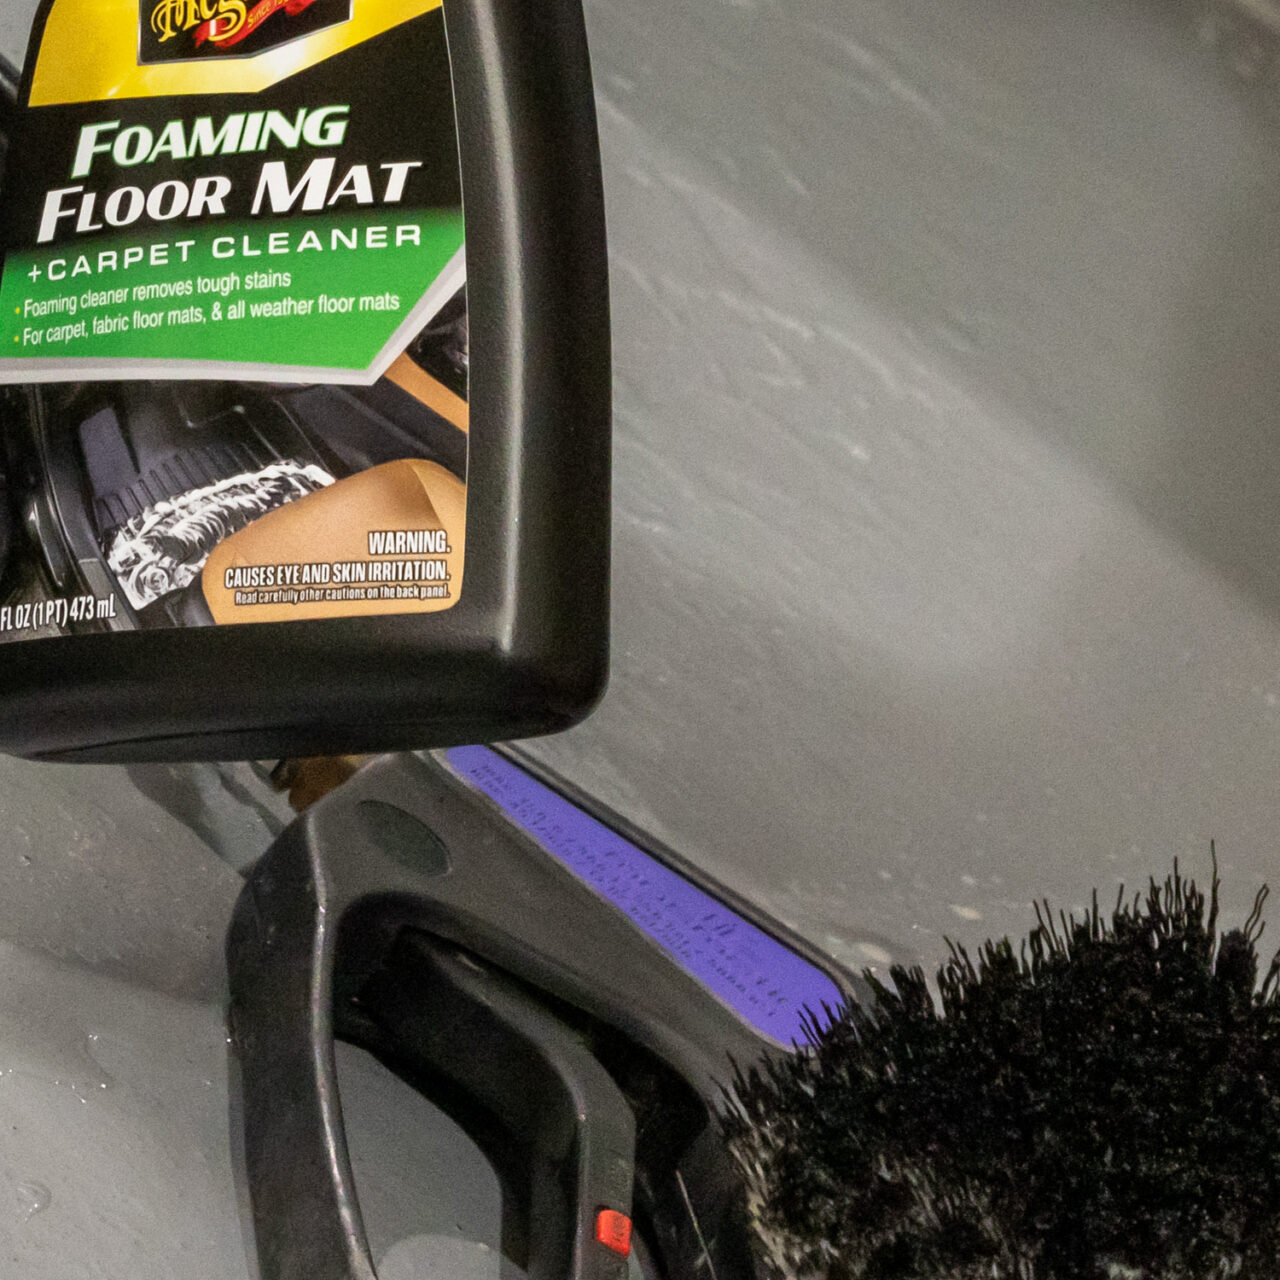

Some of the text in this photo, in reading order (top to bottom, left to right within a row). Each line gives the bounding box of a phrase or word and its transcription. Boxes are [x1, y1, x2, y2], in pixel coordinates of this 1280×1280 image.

[247, 3, 270, 29] Since
[70, 104, 351, 179] FOAMING
[37, 157, 424, 243] FLOOR MAT
[212, 225, 421, 259] CLEANER
[23, 269, 292, 319] Foaming cleaner removes tough stains
[23, 292, 400, 346] For carpet, fabric floor mats, & all weather floor mats
[368, 530, 451, 554] WARNING.
[225, 560, 450, 588] CAUSES EYE AND SKIN IRRITATION.
[0, 606, 13, 631] FL
[15, 604, 31, 629] OZ
[32, 601, 43, 630] (1
[46, 598, 68, 627] PT)
[69, 595, 95, 621] 473
[96, 593, 116, 618] mL
[235, 585, 451, 604] Read carefully other cautions on the back panel.
